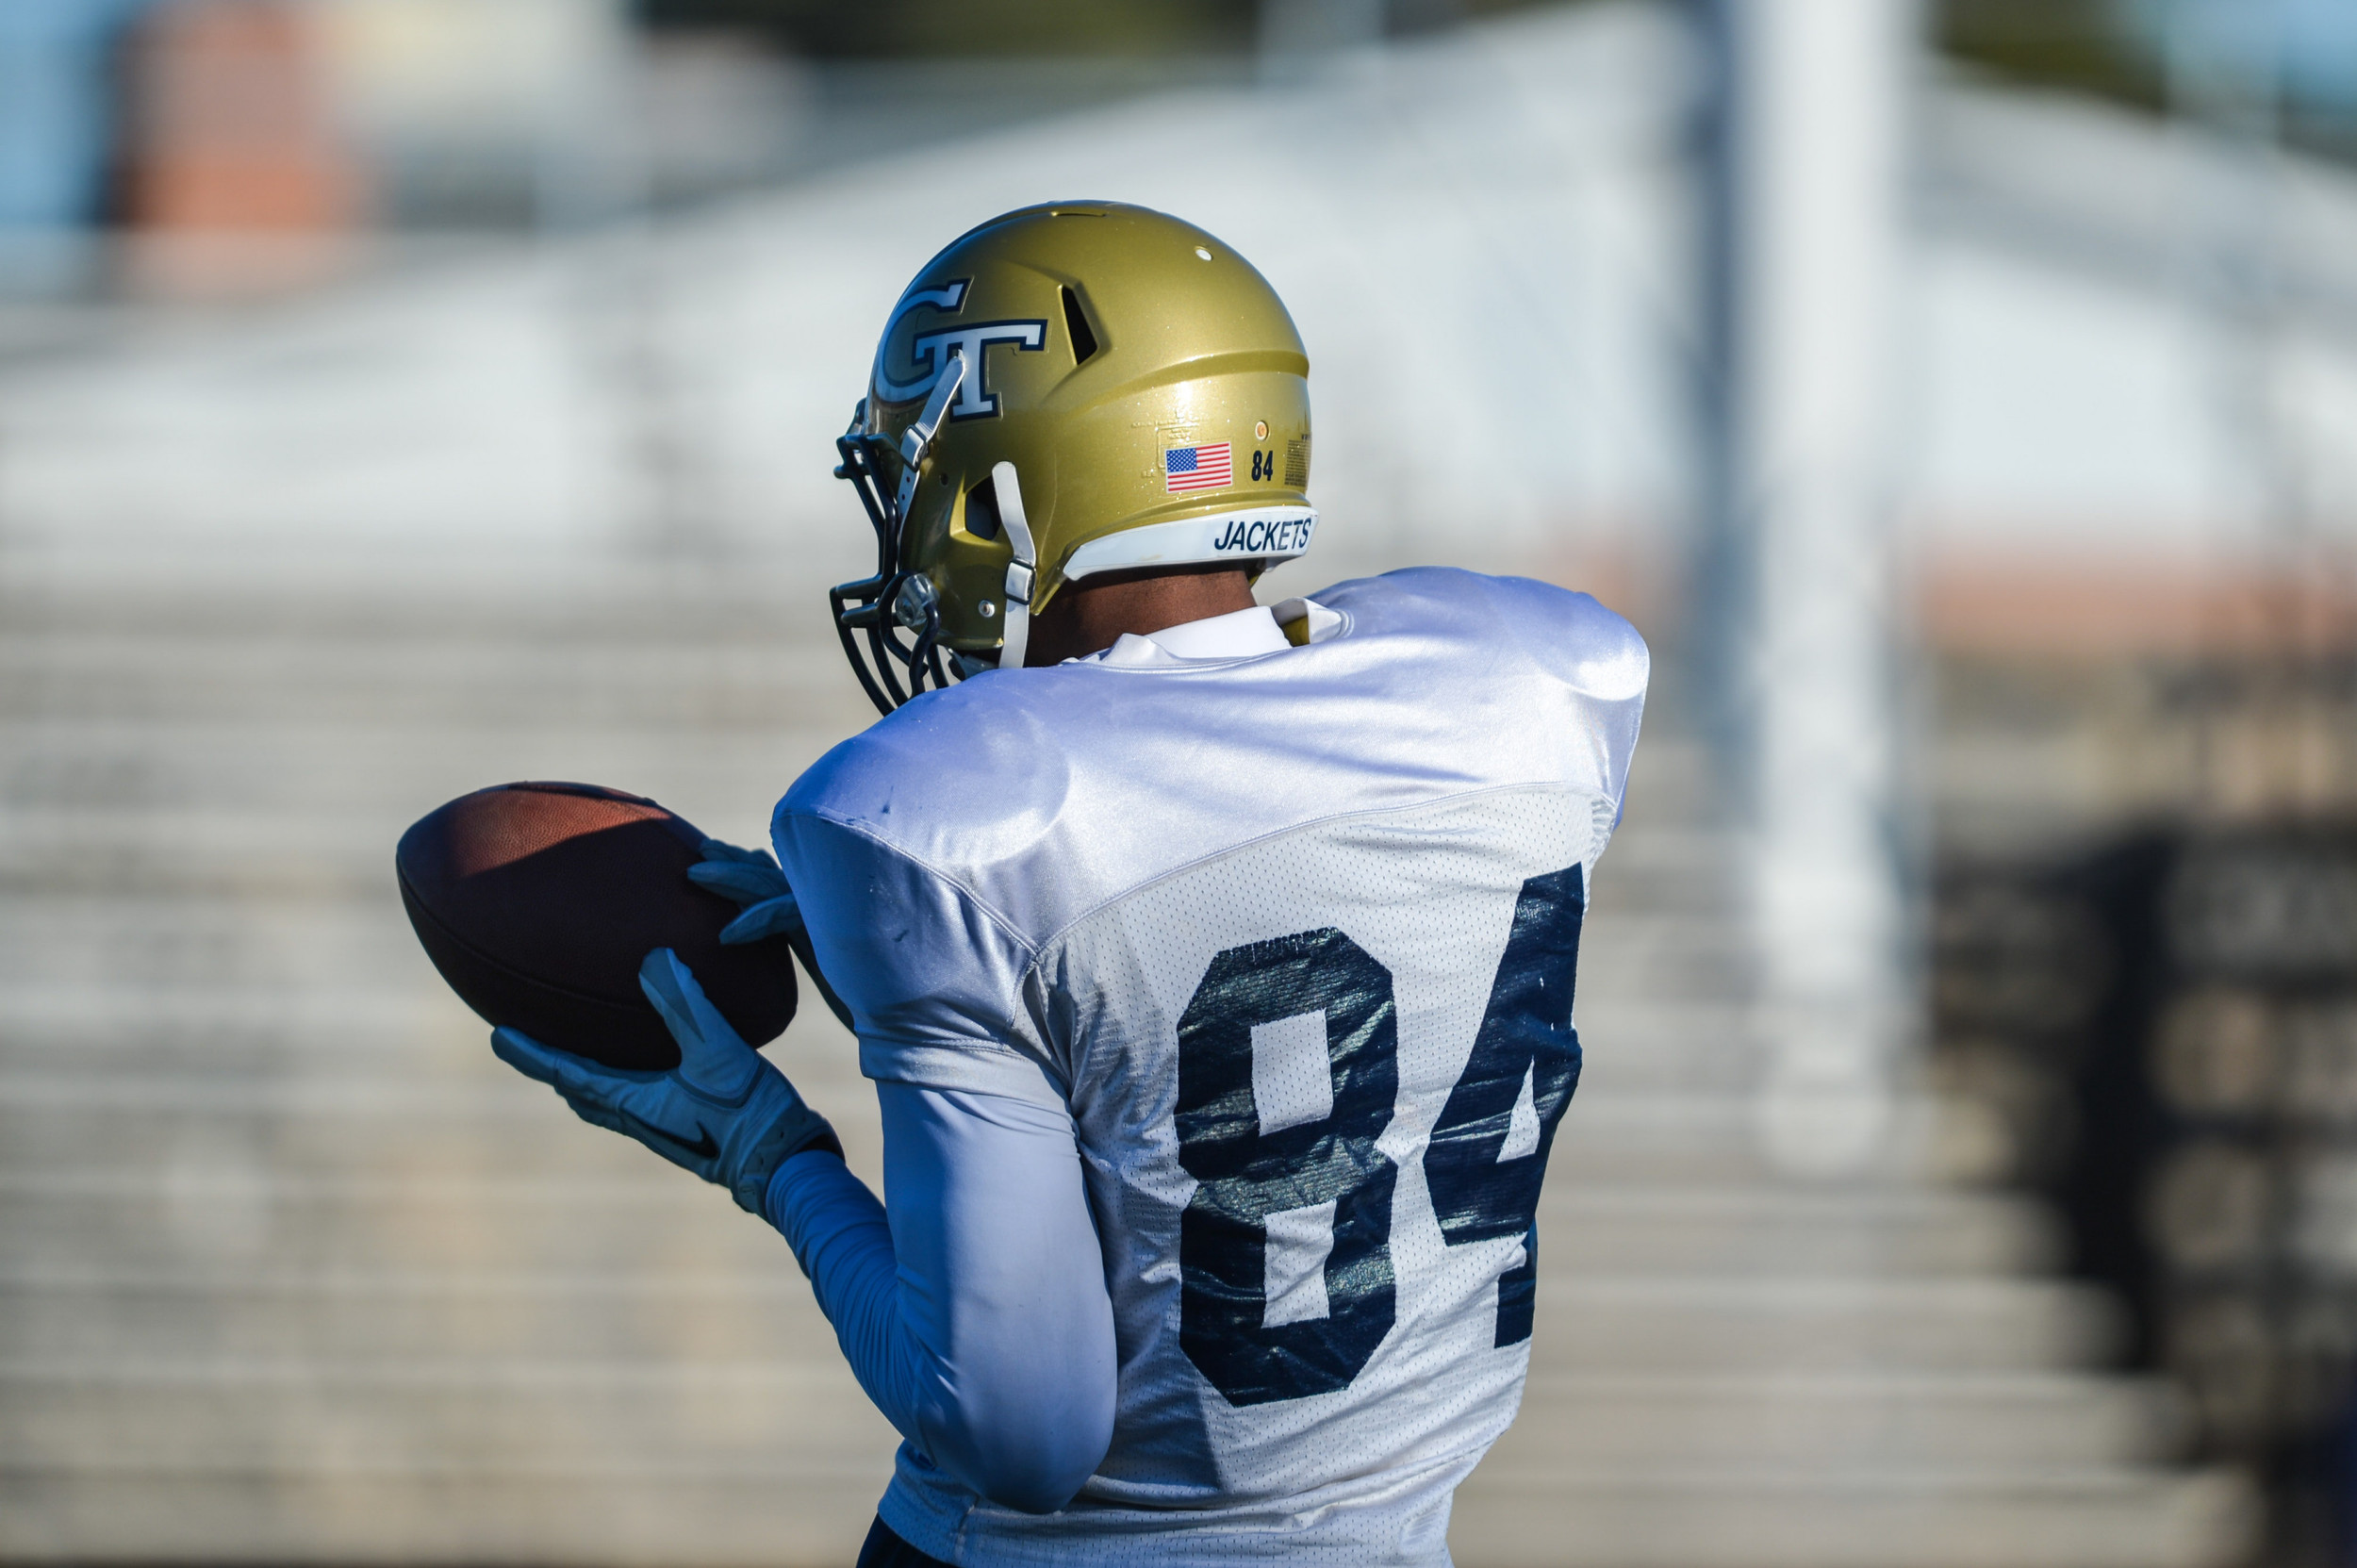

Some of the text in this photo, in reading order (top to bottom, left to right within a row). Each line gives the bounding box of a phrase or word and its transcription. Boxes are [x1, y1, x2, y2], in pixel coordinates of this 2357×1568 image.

[875, 277, 1047, 422] GT
[1251, 450, 1273, 481] 84
[1214, 518, 1311, 552] JACKETS
[1175, 862, 1582, 1407] 84
